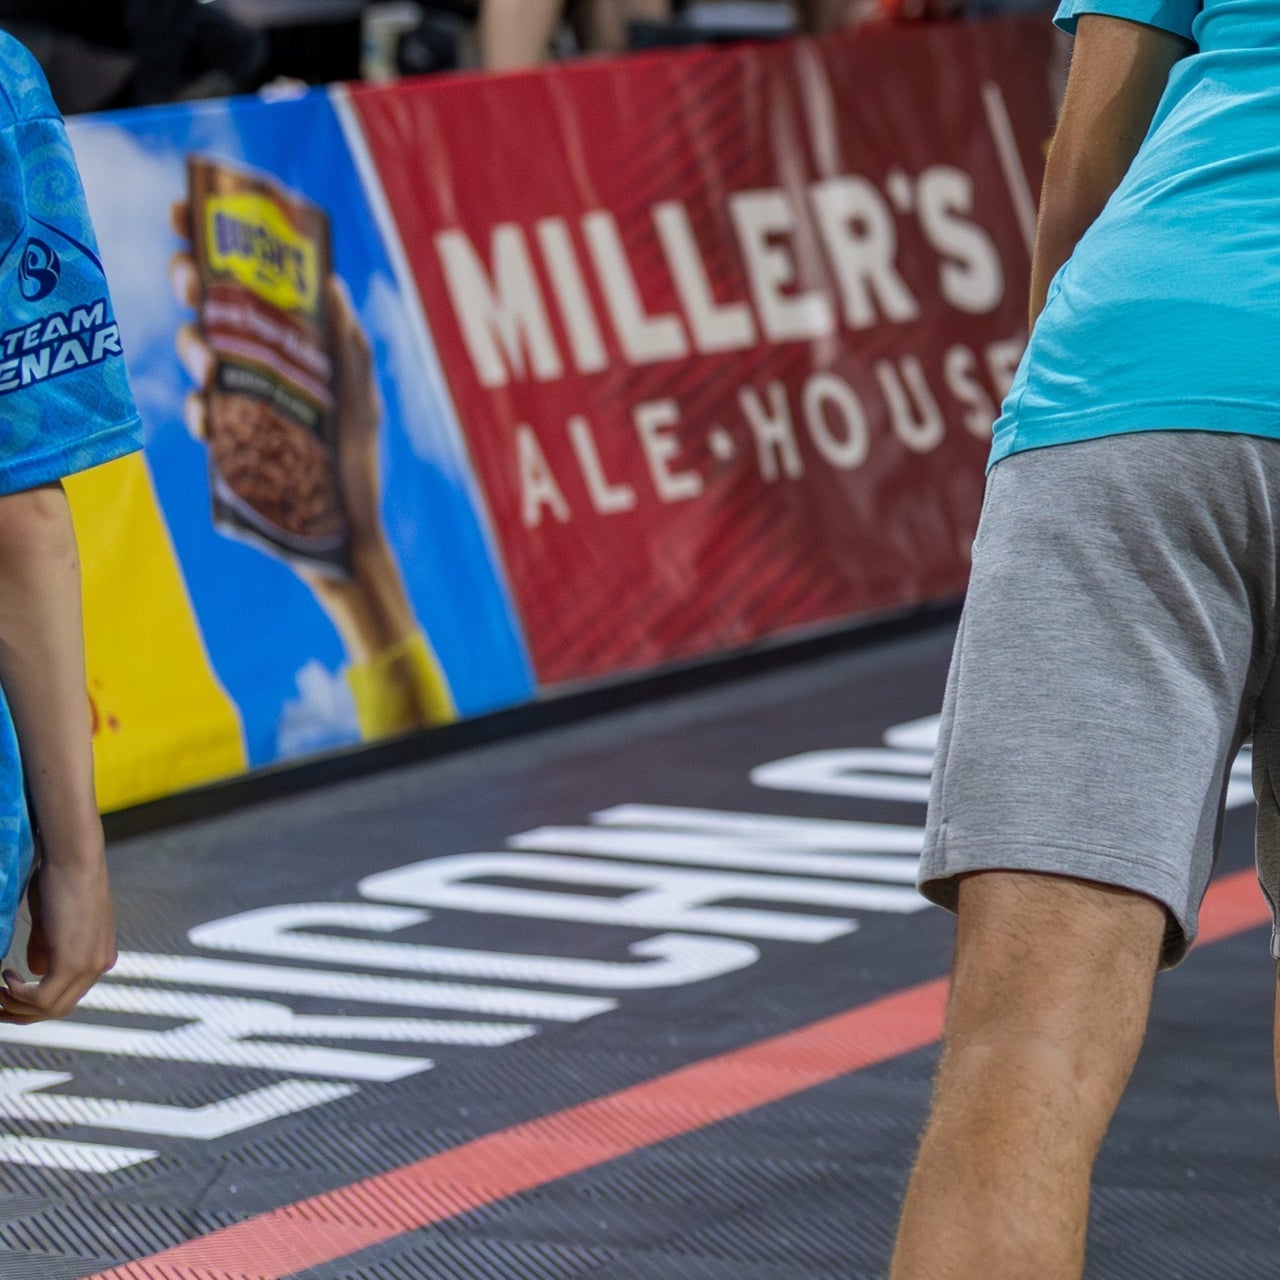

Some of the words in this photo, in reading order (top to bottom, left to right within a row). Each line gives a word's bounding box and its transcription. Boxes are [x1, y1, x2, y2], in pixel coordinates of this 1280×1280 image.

[433, 165, 1004, 389] MILLER'S
[0, 322, 122, 393] ENAR
[3, 300, 105, 356] TEAM
[515, 397, 702, 528] ALE
